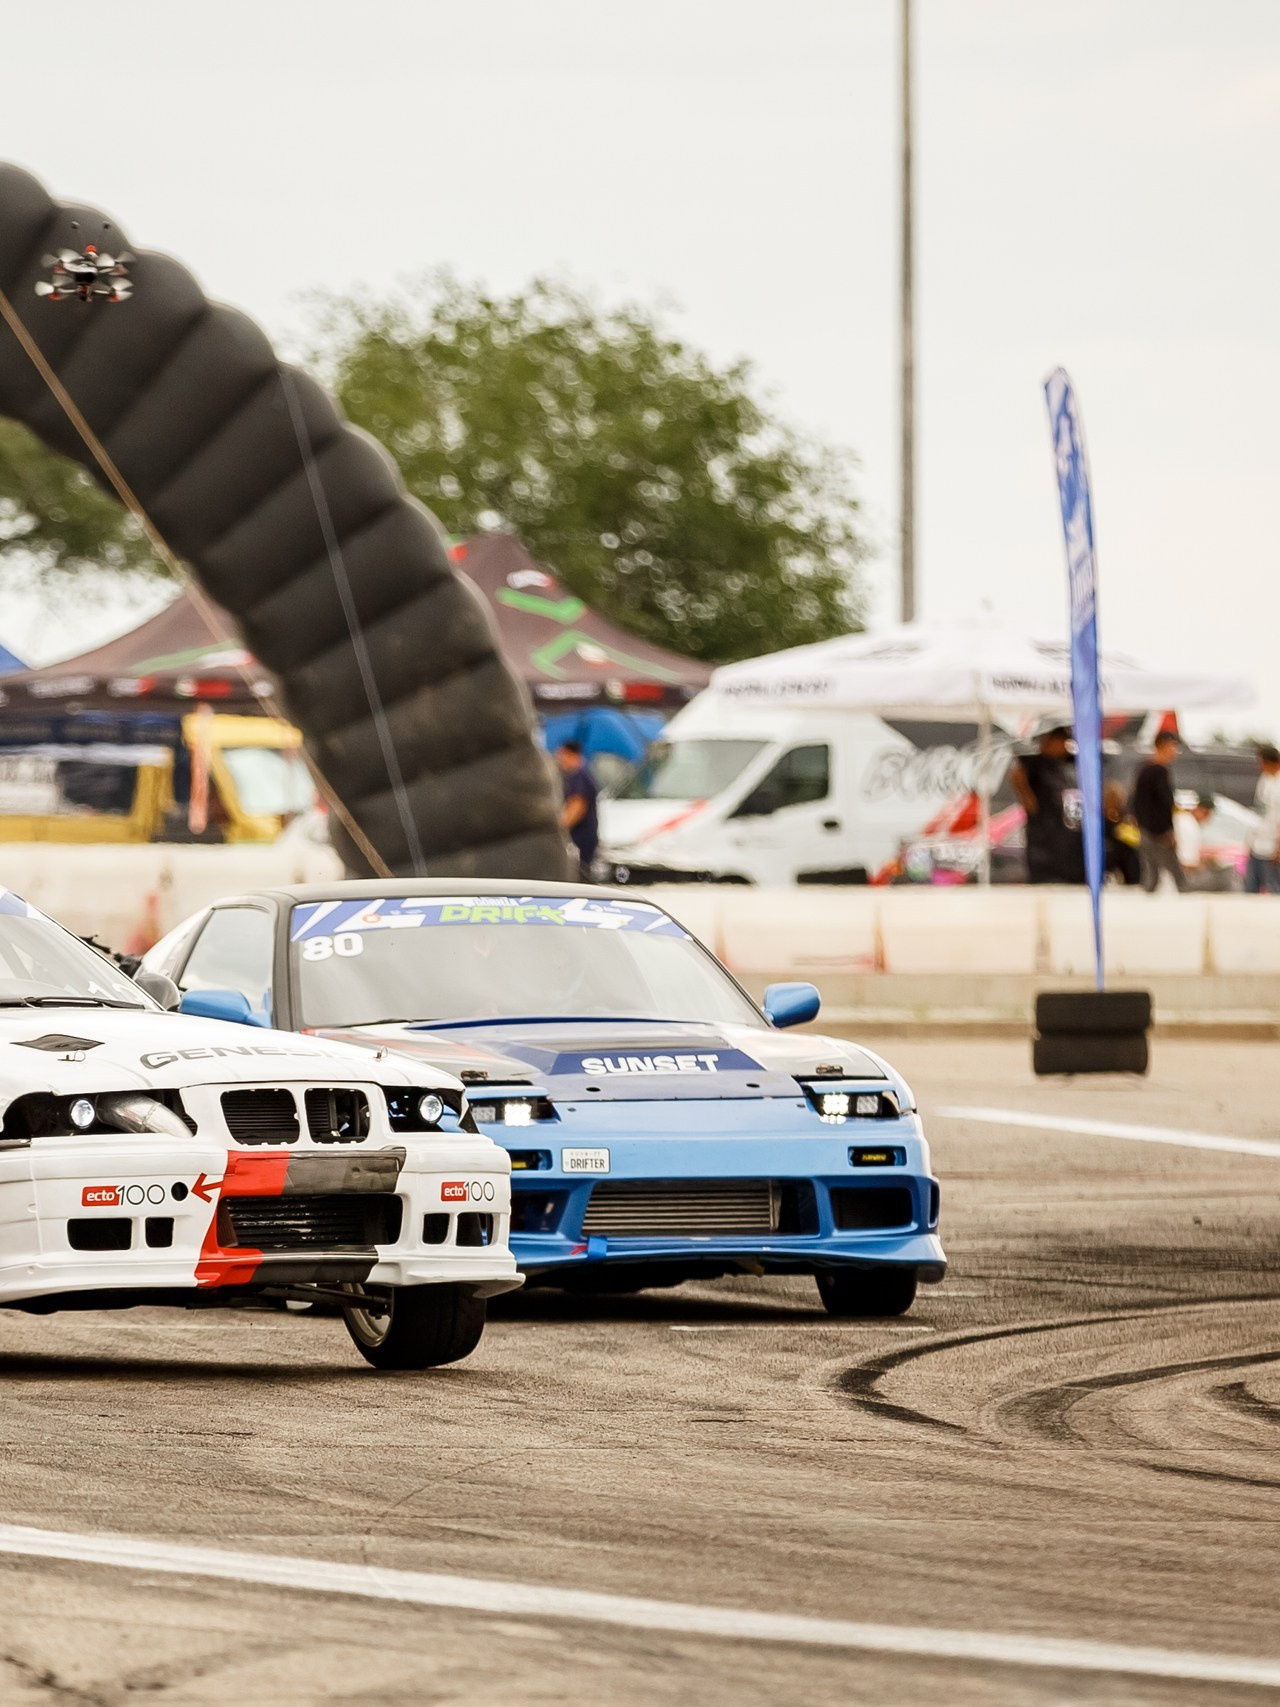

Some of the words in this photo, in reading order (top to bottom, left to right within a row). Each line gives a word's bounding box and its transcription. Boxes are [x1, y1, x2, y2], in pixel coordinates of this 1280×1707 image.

[440, 905, 566, 925] DRIFT
[302, 932, 364, 962] 80
[581, 1054, 719, 1076] SUNSET
[570, 1158, 605, 1169] DRIFTER
